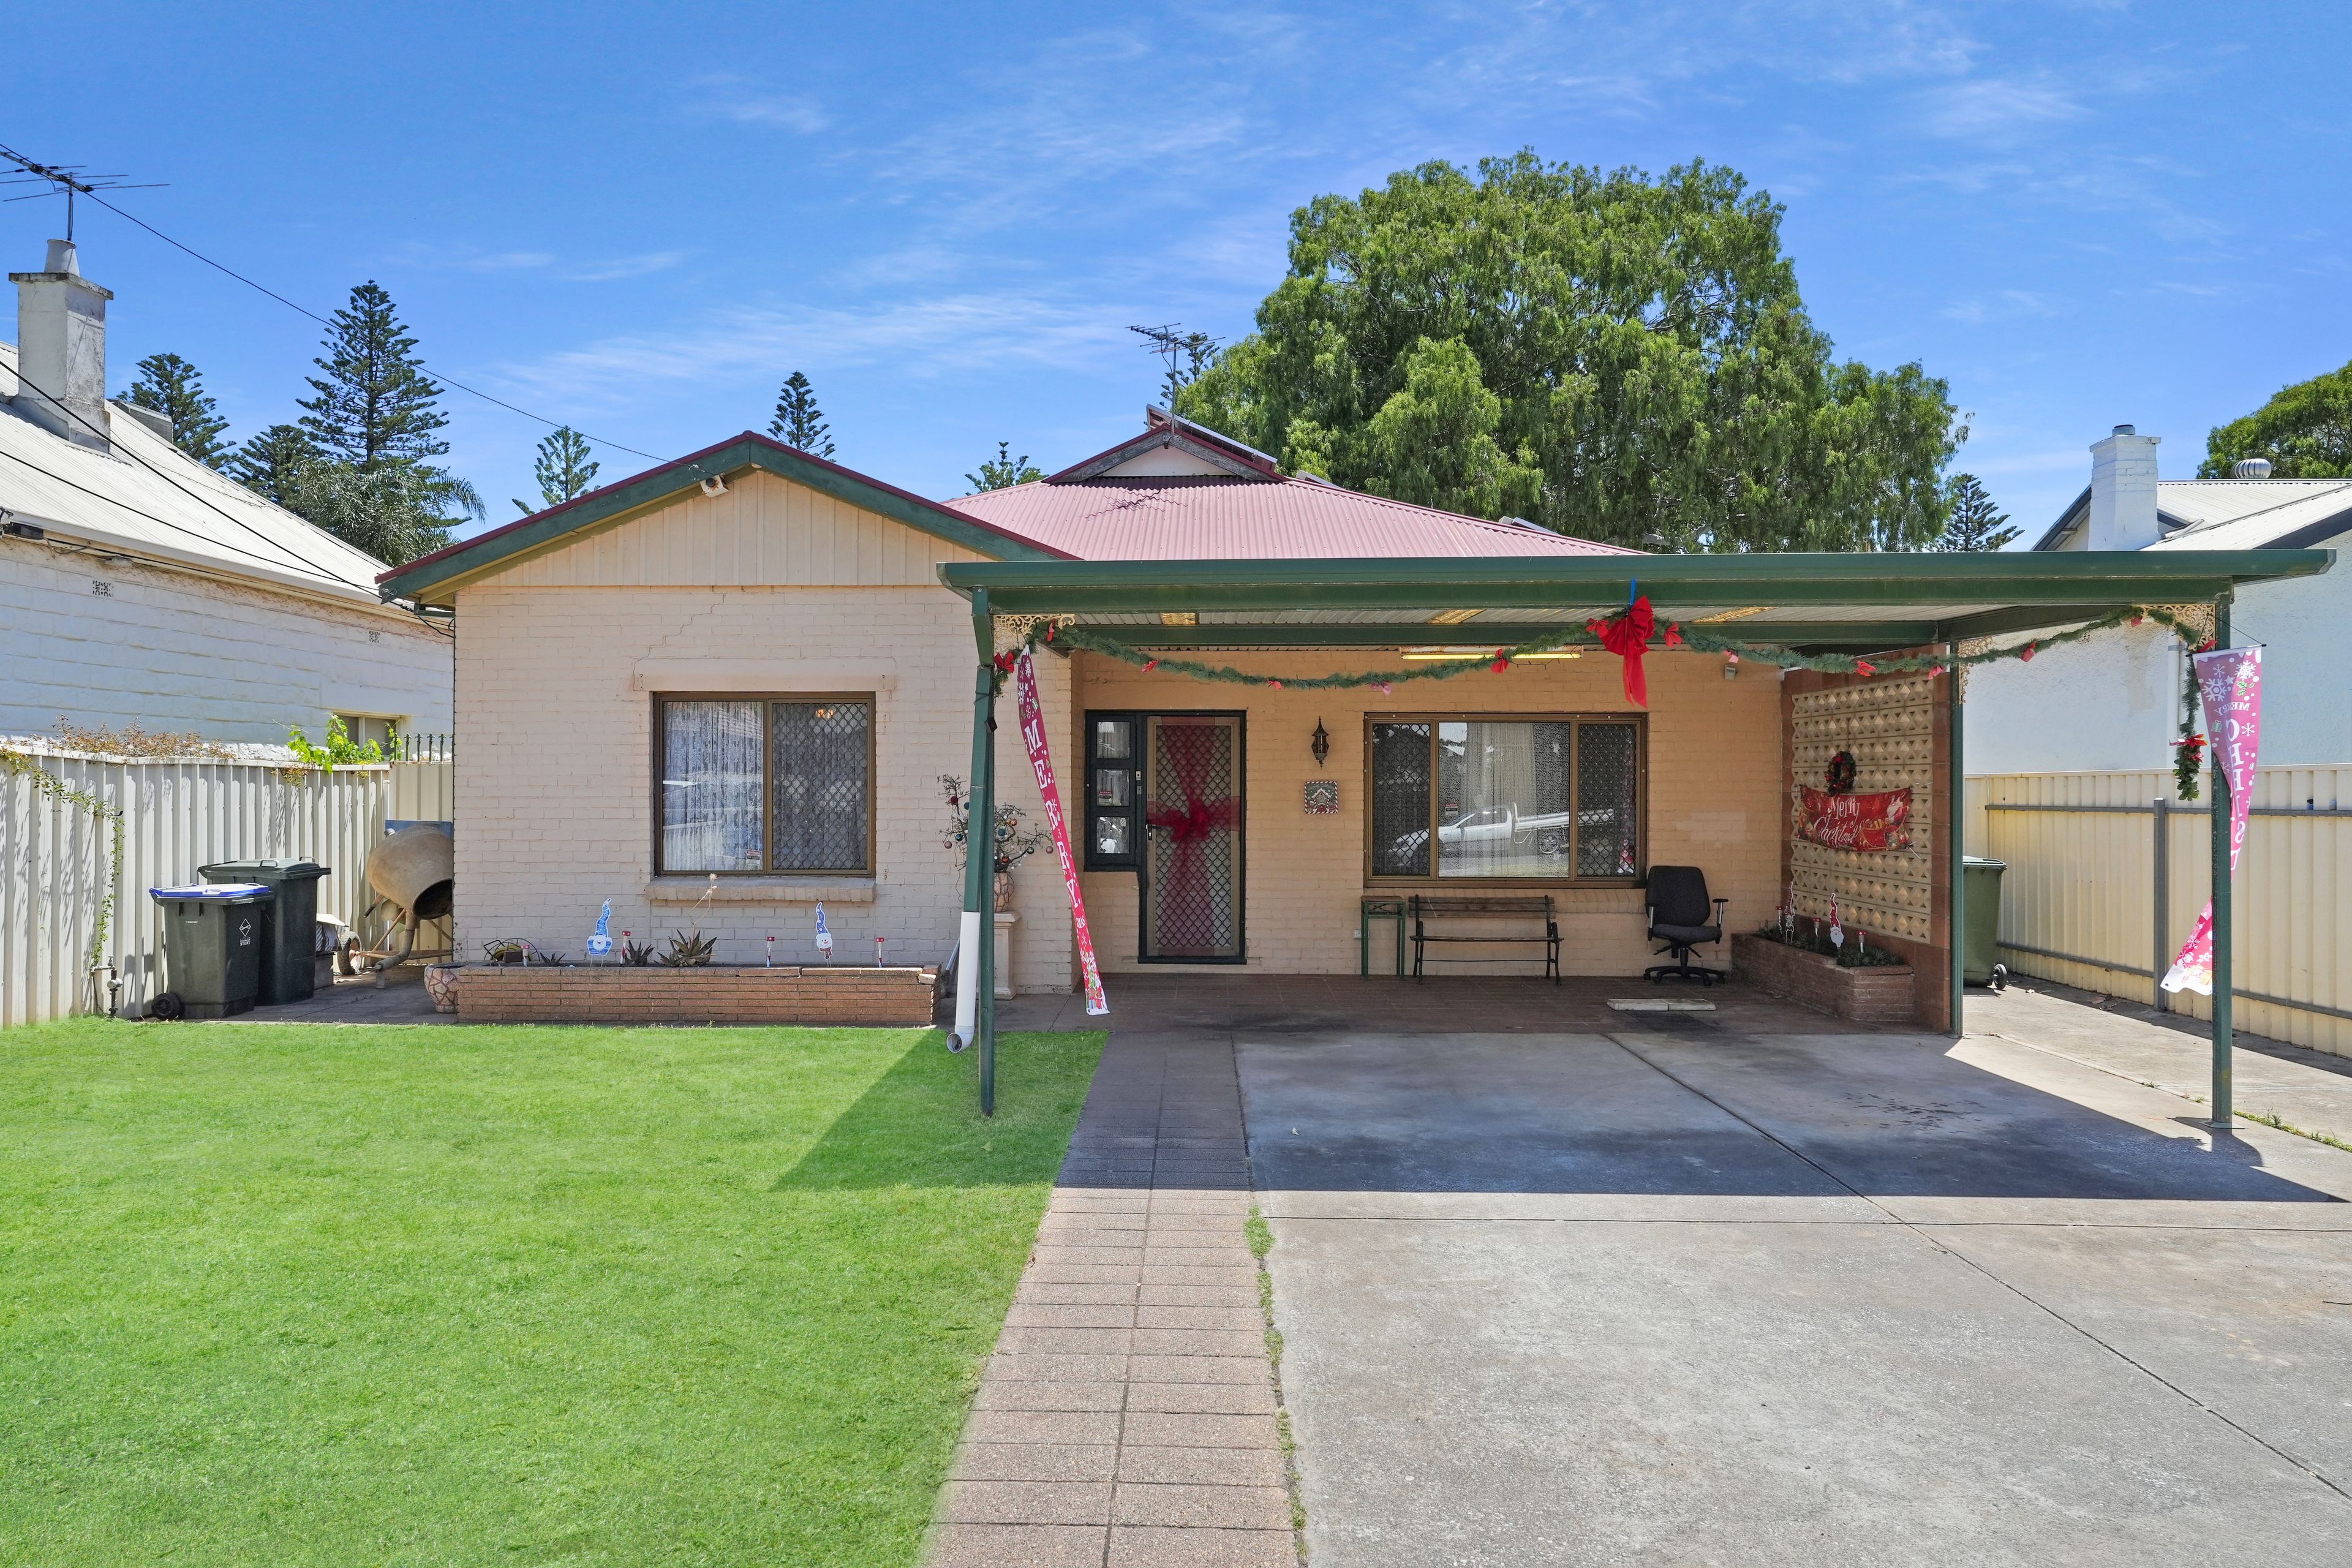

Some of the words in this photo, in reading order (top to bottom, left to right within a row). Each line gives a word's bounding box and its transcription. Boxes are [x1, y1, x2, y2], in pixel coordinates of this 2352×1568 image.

[1024, 718, 1079, 908] MERRY
[1827, 796, 1860, 828] Merry
[1814, 813, 1862, 848] Christmas
